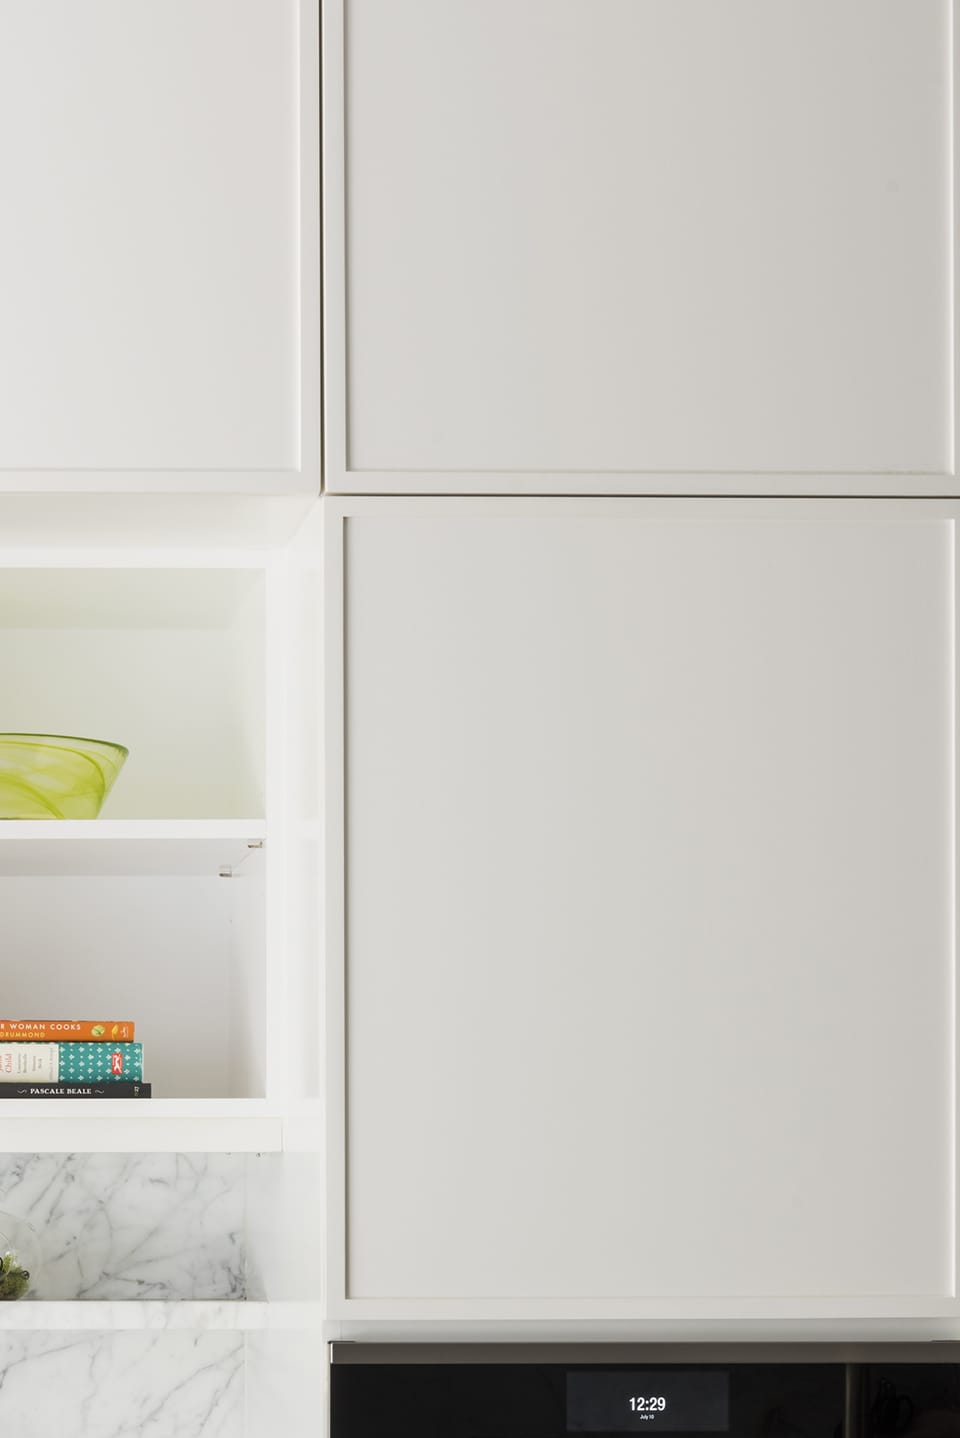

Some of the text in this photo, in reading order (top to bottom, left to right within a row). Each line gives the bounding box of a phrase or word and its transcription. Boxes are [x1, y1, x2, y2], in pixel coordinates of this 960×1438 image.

[9, 1023, 46, 1031] WOMAN
[50, 1023, 81, 1031] COOKS
[629, 1397, 666, 1411] 12:29
